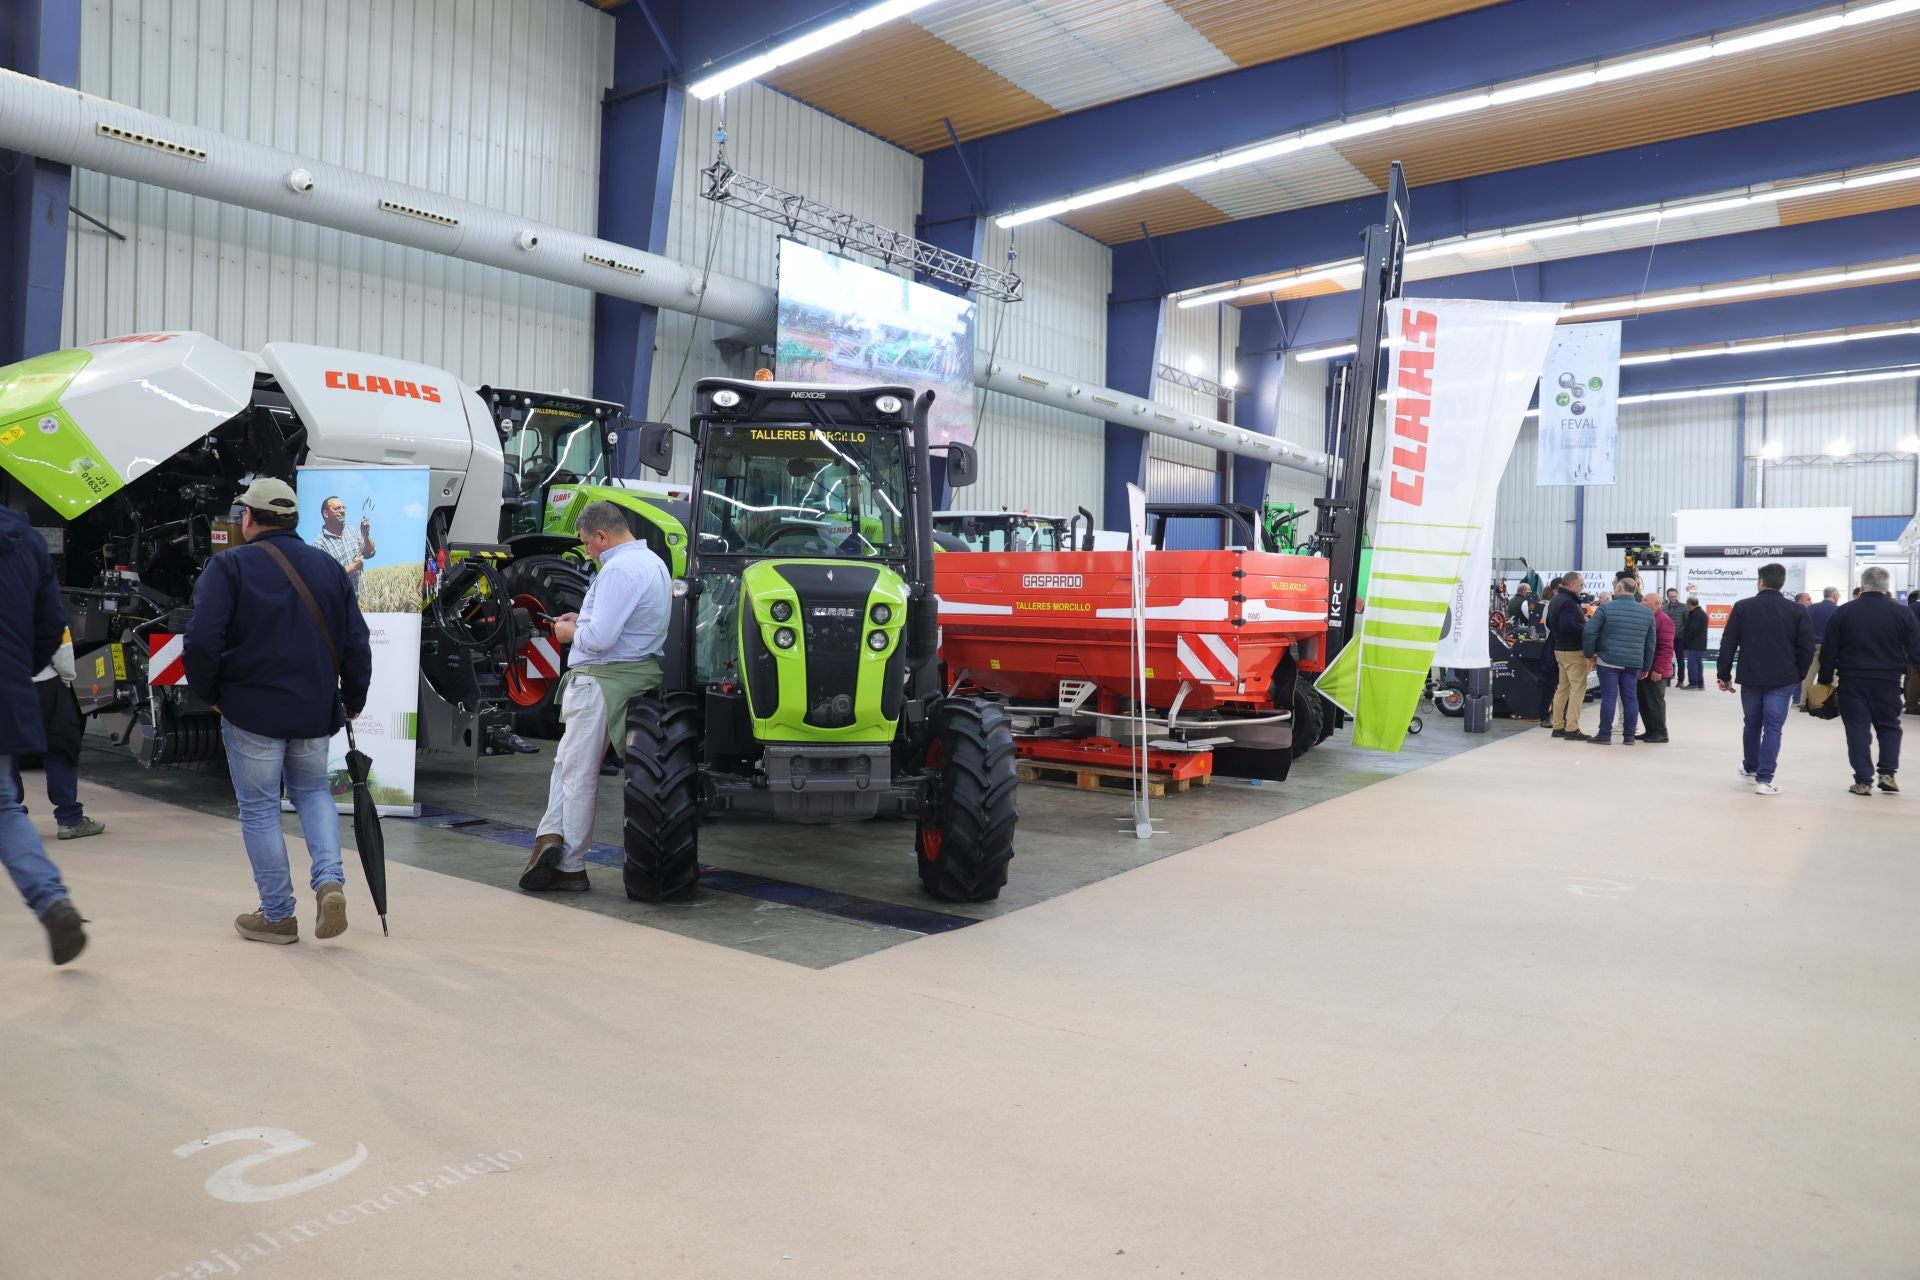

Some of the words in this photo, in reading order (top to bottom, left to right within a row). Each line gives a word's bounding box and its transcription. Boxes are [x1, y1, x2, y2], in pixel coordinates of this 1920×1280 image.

[325, 371, 441, 403] CLAAS
[791, 391, 826, 399] NEXOS
[534, 407, 558, 416] TALLERES
[1390, 308, 1438, 507] CLAAS
[1561, 418, 1597, 429] FEVAL
[750, 429, 806, 440] TALLERES
[81, 472, 102, 494] 01632
[95, 475, 110, 489] J31
[1724, 547, 1750, 556] QUALITY
[1763, 547, 1785, 555] PLANT
[1024, 576, 1081, 587] GASPARDO
[1331, 582, 1343, 616] KPC
[1016, 602, 1051, 610] TALLERES
[1052, 602, 1091, 611] MORCILLO
